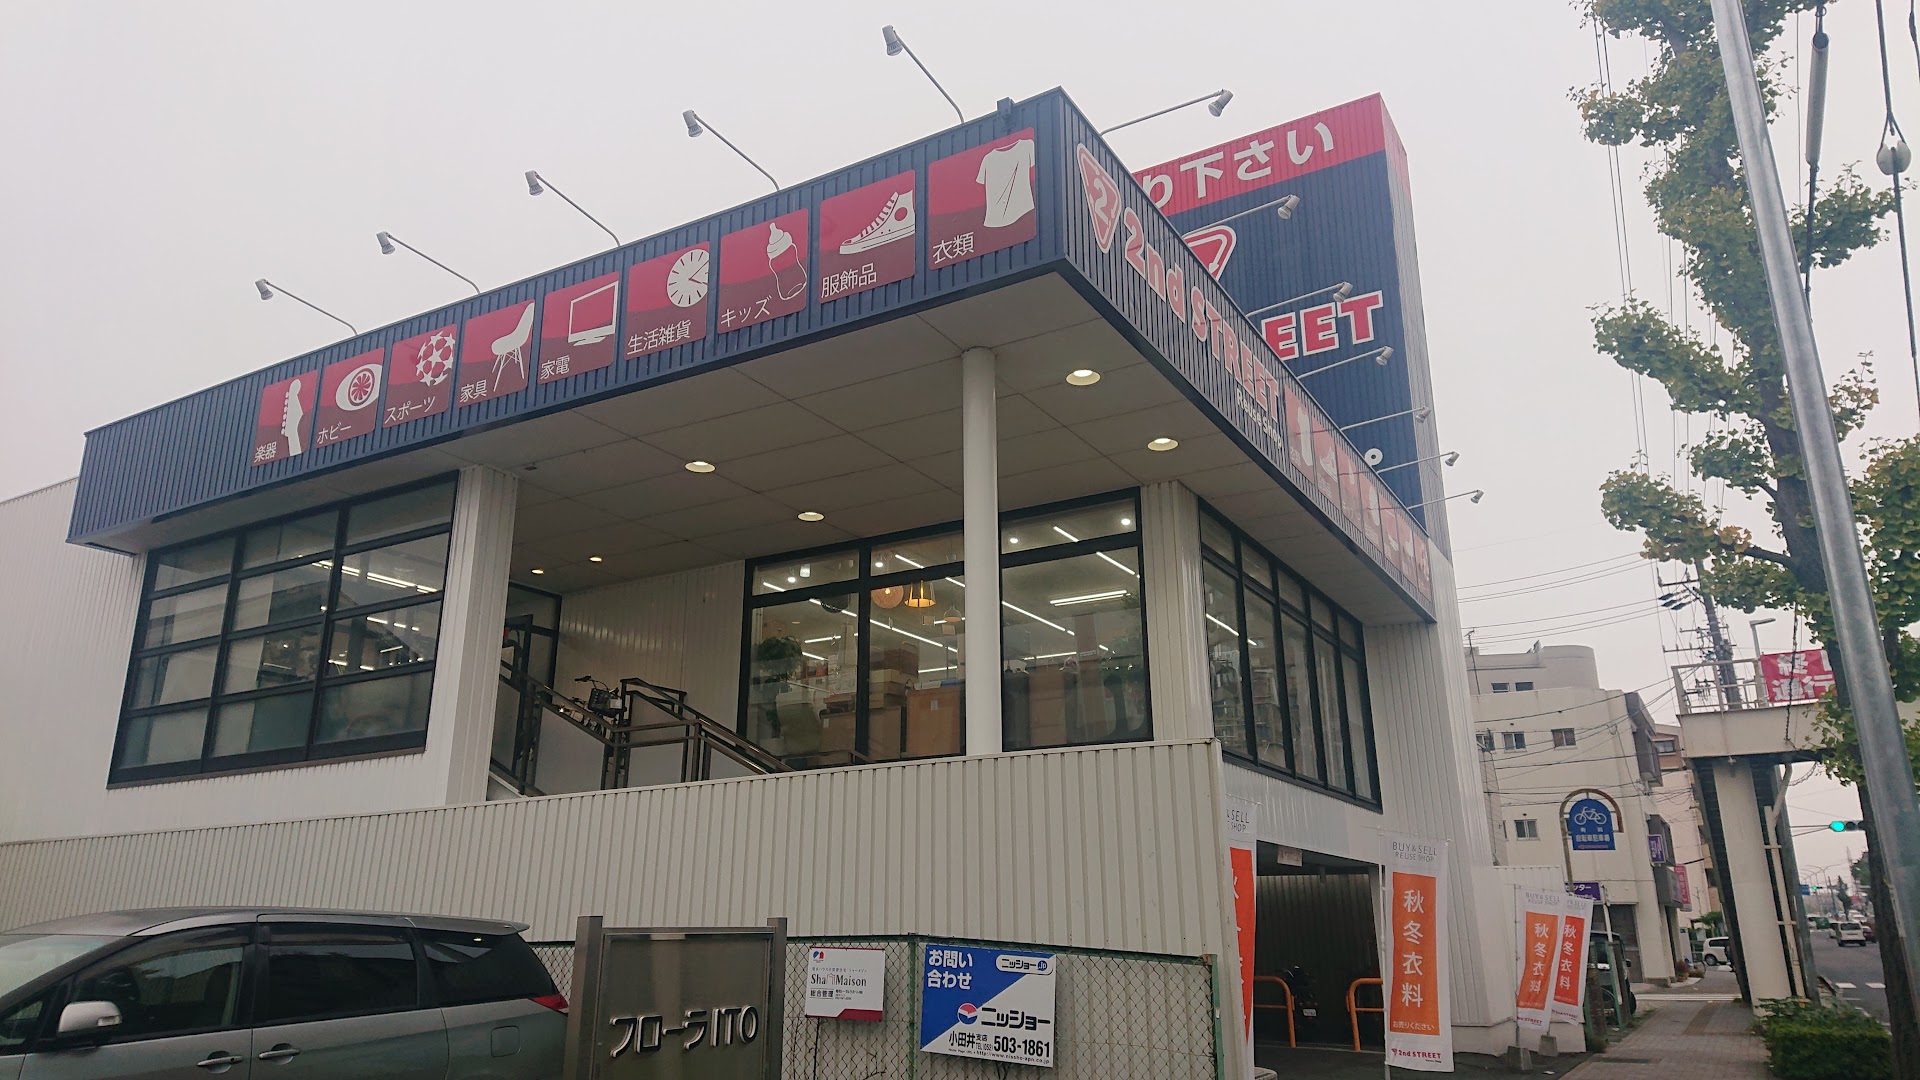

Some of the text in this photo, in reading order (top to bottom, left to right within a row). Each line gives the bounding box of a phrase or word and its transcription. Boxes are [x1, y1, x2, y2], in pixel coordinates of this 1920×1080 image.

[933, 232, 975, 263] 衣類
[821, 263, 877, 298] 服飾品
[721, 295, 772, 328] キッズ
[1124, 207, 1185, 324] 2nd
[1191, 286, 1278, 424] STREET
[627, 320, 691, 355] 生活雑貨
[541, 355, 570, 380] 家電
[459, 379, 487, 403] 家具
[384, 396, 436, 424] スポーツ
[1236, 388, 1282, 448] Reuse Shop
[317, 423, 351, 444] ホビー
[254, 441, 277, 463] 楽器
[1394, 851, 1434, 863] REUSE SHOP
[928, 949, 973, 969] お問い
[1402, 889, 1424, 1009] 秋冬衣料
[1529, 922, 1550, 994] 秋冬衣料
[1560, 924, 1577, 990] 秋冬衣料
[927, 969, 972, 990] 合わせ
[810, 989, 834, 998] 総合管理
[981, 1007, 1051, 1031] ニッショー
[1392, 1020, 1435, 1031] お売りください
[948, 1031, 976, 1049] 小田井
[976, 1033, 988, 1042] 支店
[993, 1035, 1050, 1058] 503-1861
[1398, 1049, 1442, 1059] 2nd STREET
